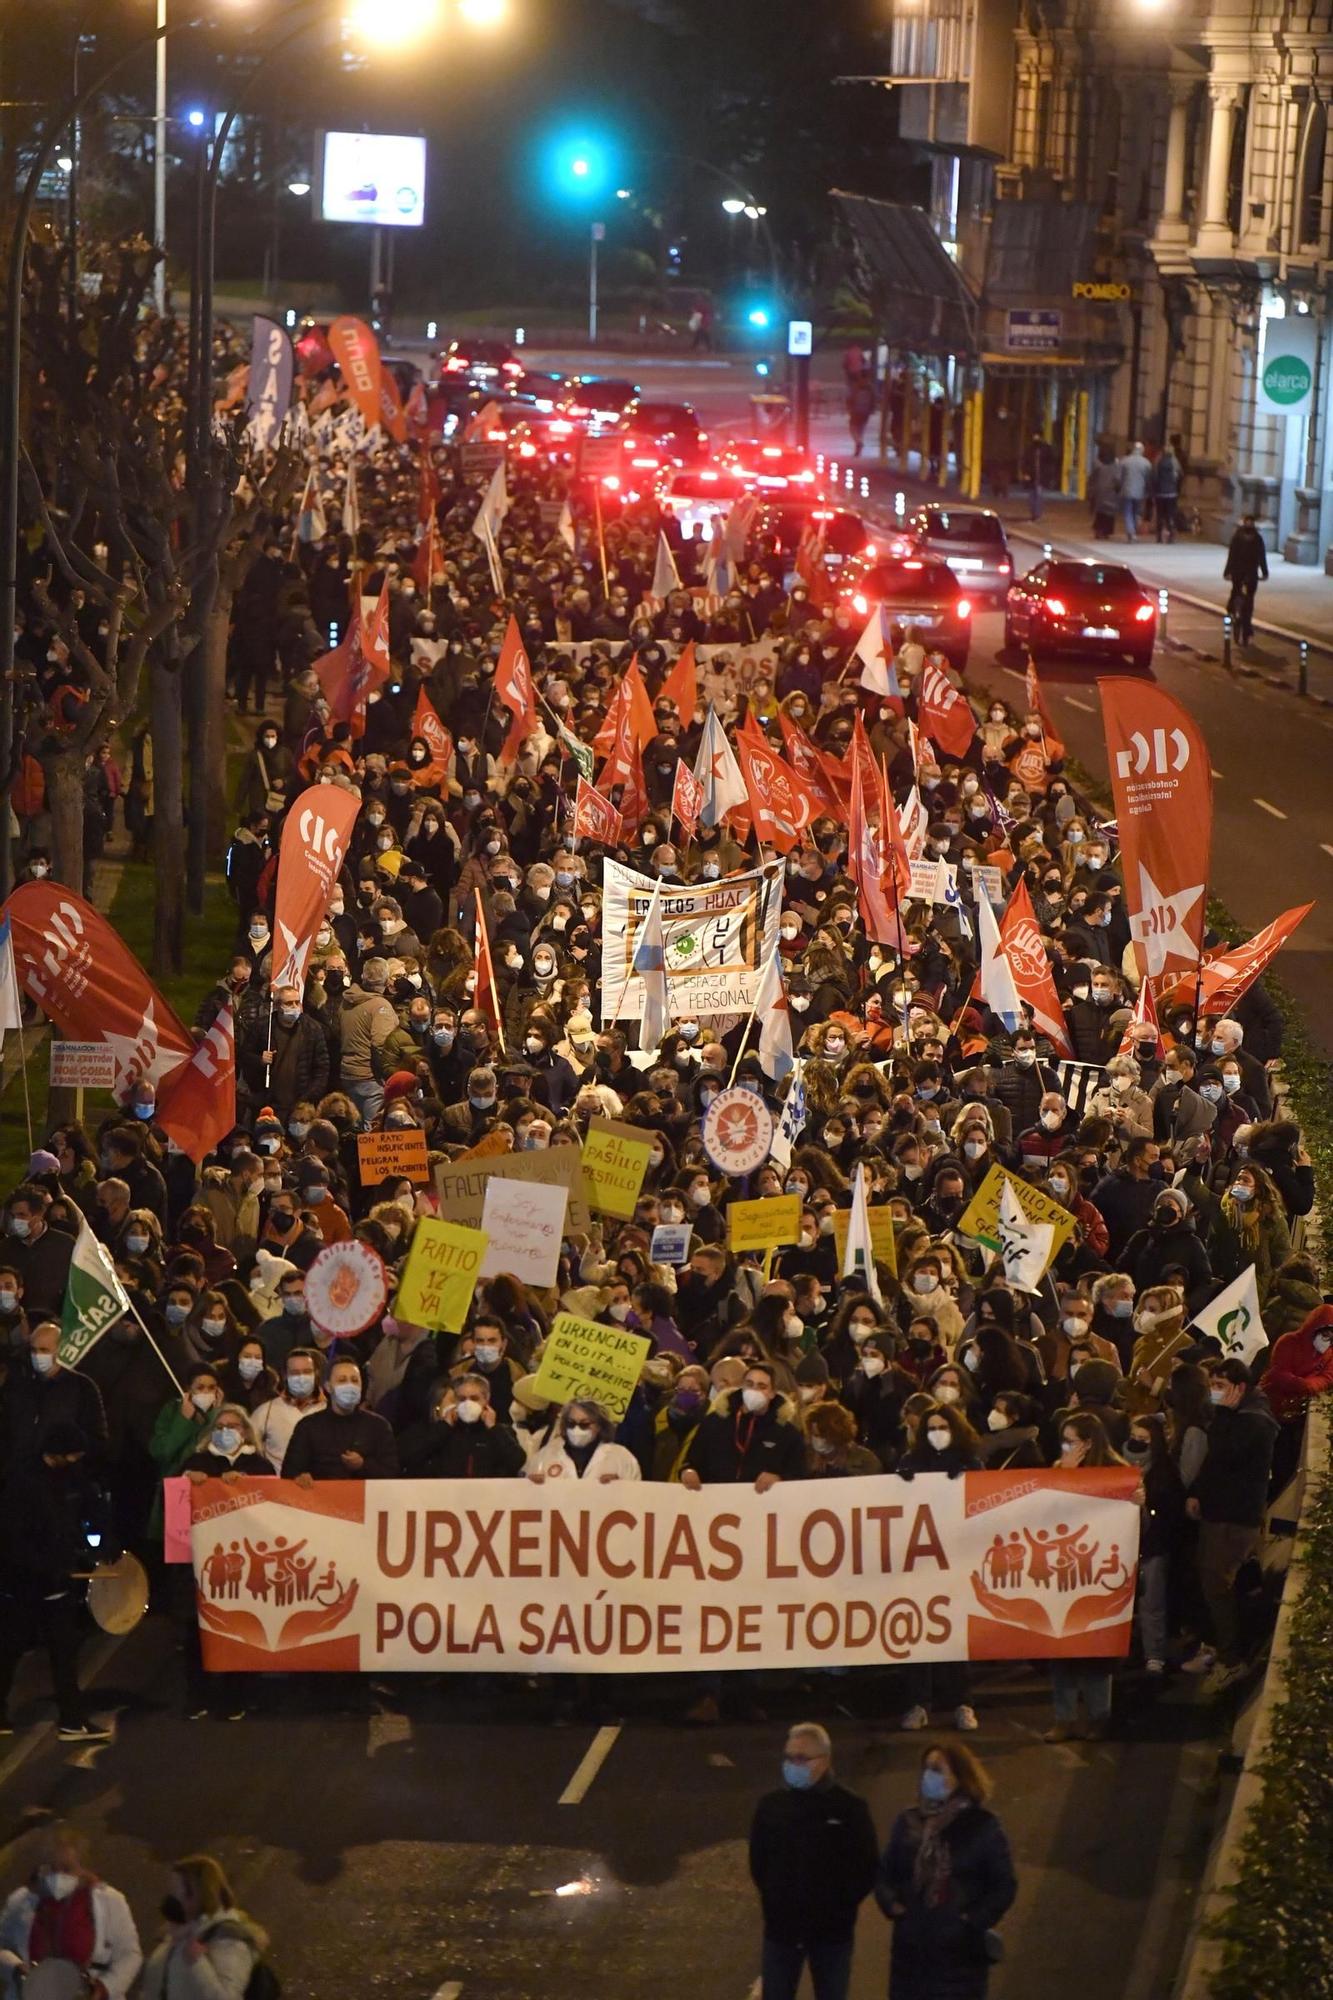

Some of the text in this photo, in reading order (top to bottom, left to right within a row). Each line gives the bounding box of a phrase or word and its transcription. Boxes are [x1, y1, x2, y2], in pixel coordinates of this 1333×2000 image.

[689, 988, 754, 1009] PERSONAL
[586, 1145, 642, 1172] PASILLO
[606, 1138, 625, 1154] AL
[582, 1165, 637, 1192] PESTILLO
[1048, 1209, 1069, 1226] EN
[420, 1237, 479, 1272] RATIO
[419, 1291, 441, 1316] YA
[559, 1321, 639, 1356] URXENCIAS
[376, 1503, 951, 1582] URXENCIAS LOITA
[375, 1589, 953, 1660] POLA SAÚDE DE TOD@S
